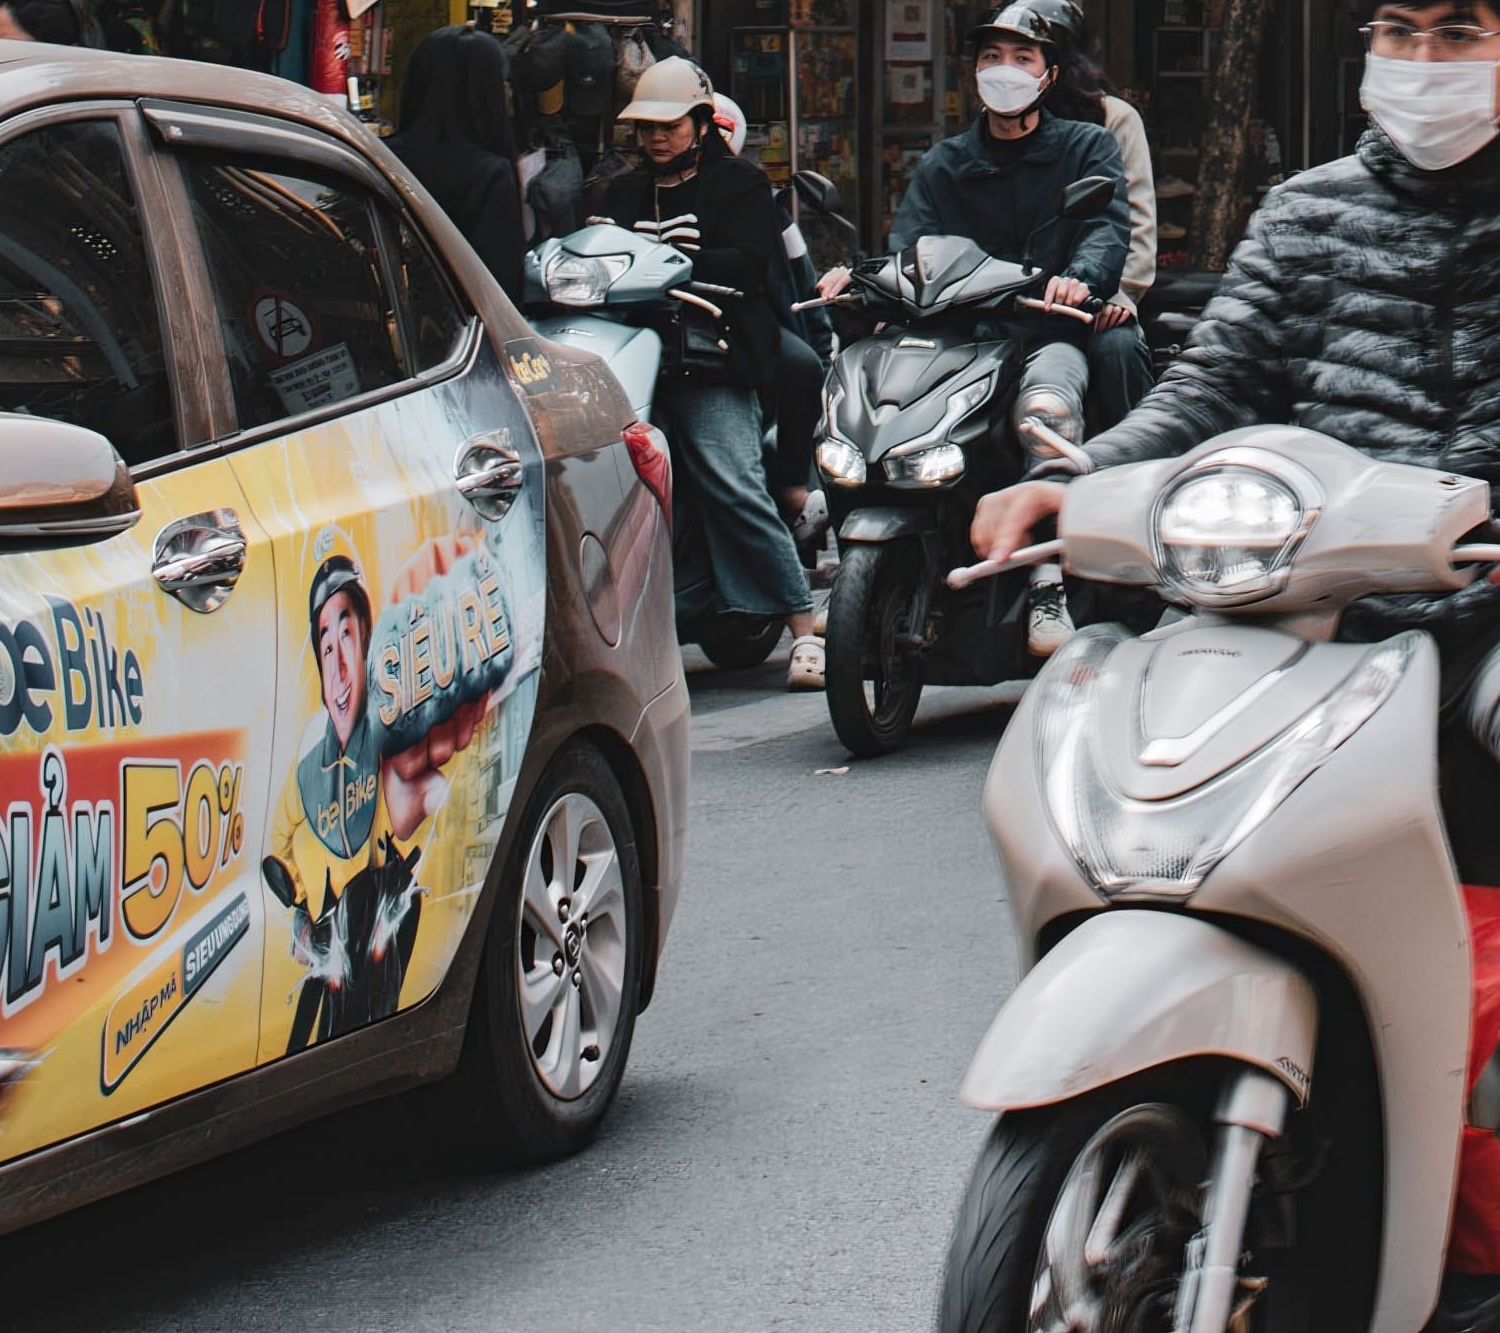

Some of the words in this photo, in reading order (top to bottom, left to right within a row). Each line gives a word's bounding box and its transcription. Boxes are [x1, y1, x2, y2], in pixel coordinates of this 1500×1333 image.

[377, 603, 457, 726] SIÊU
[345, 773, 378, 820] Bike
[120, 758, 246, 940] 50%
[116, 996, 160, 1056] NHẬP
